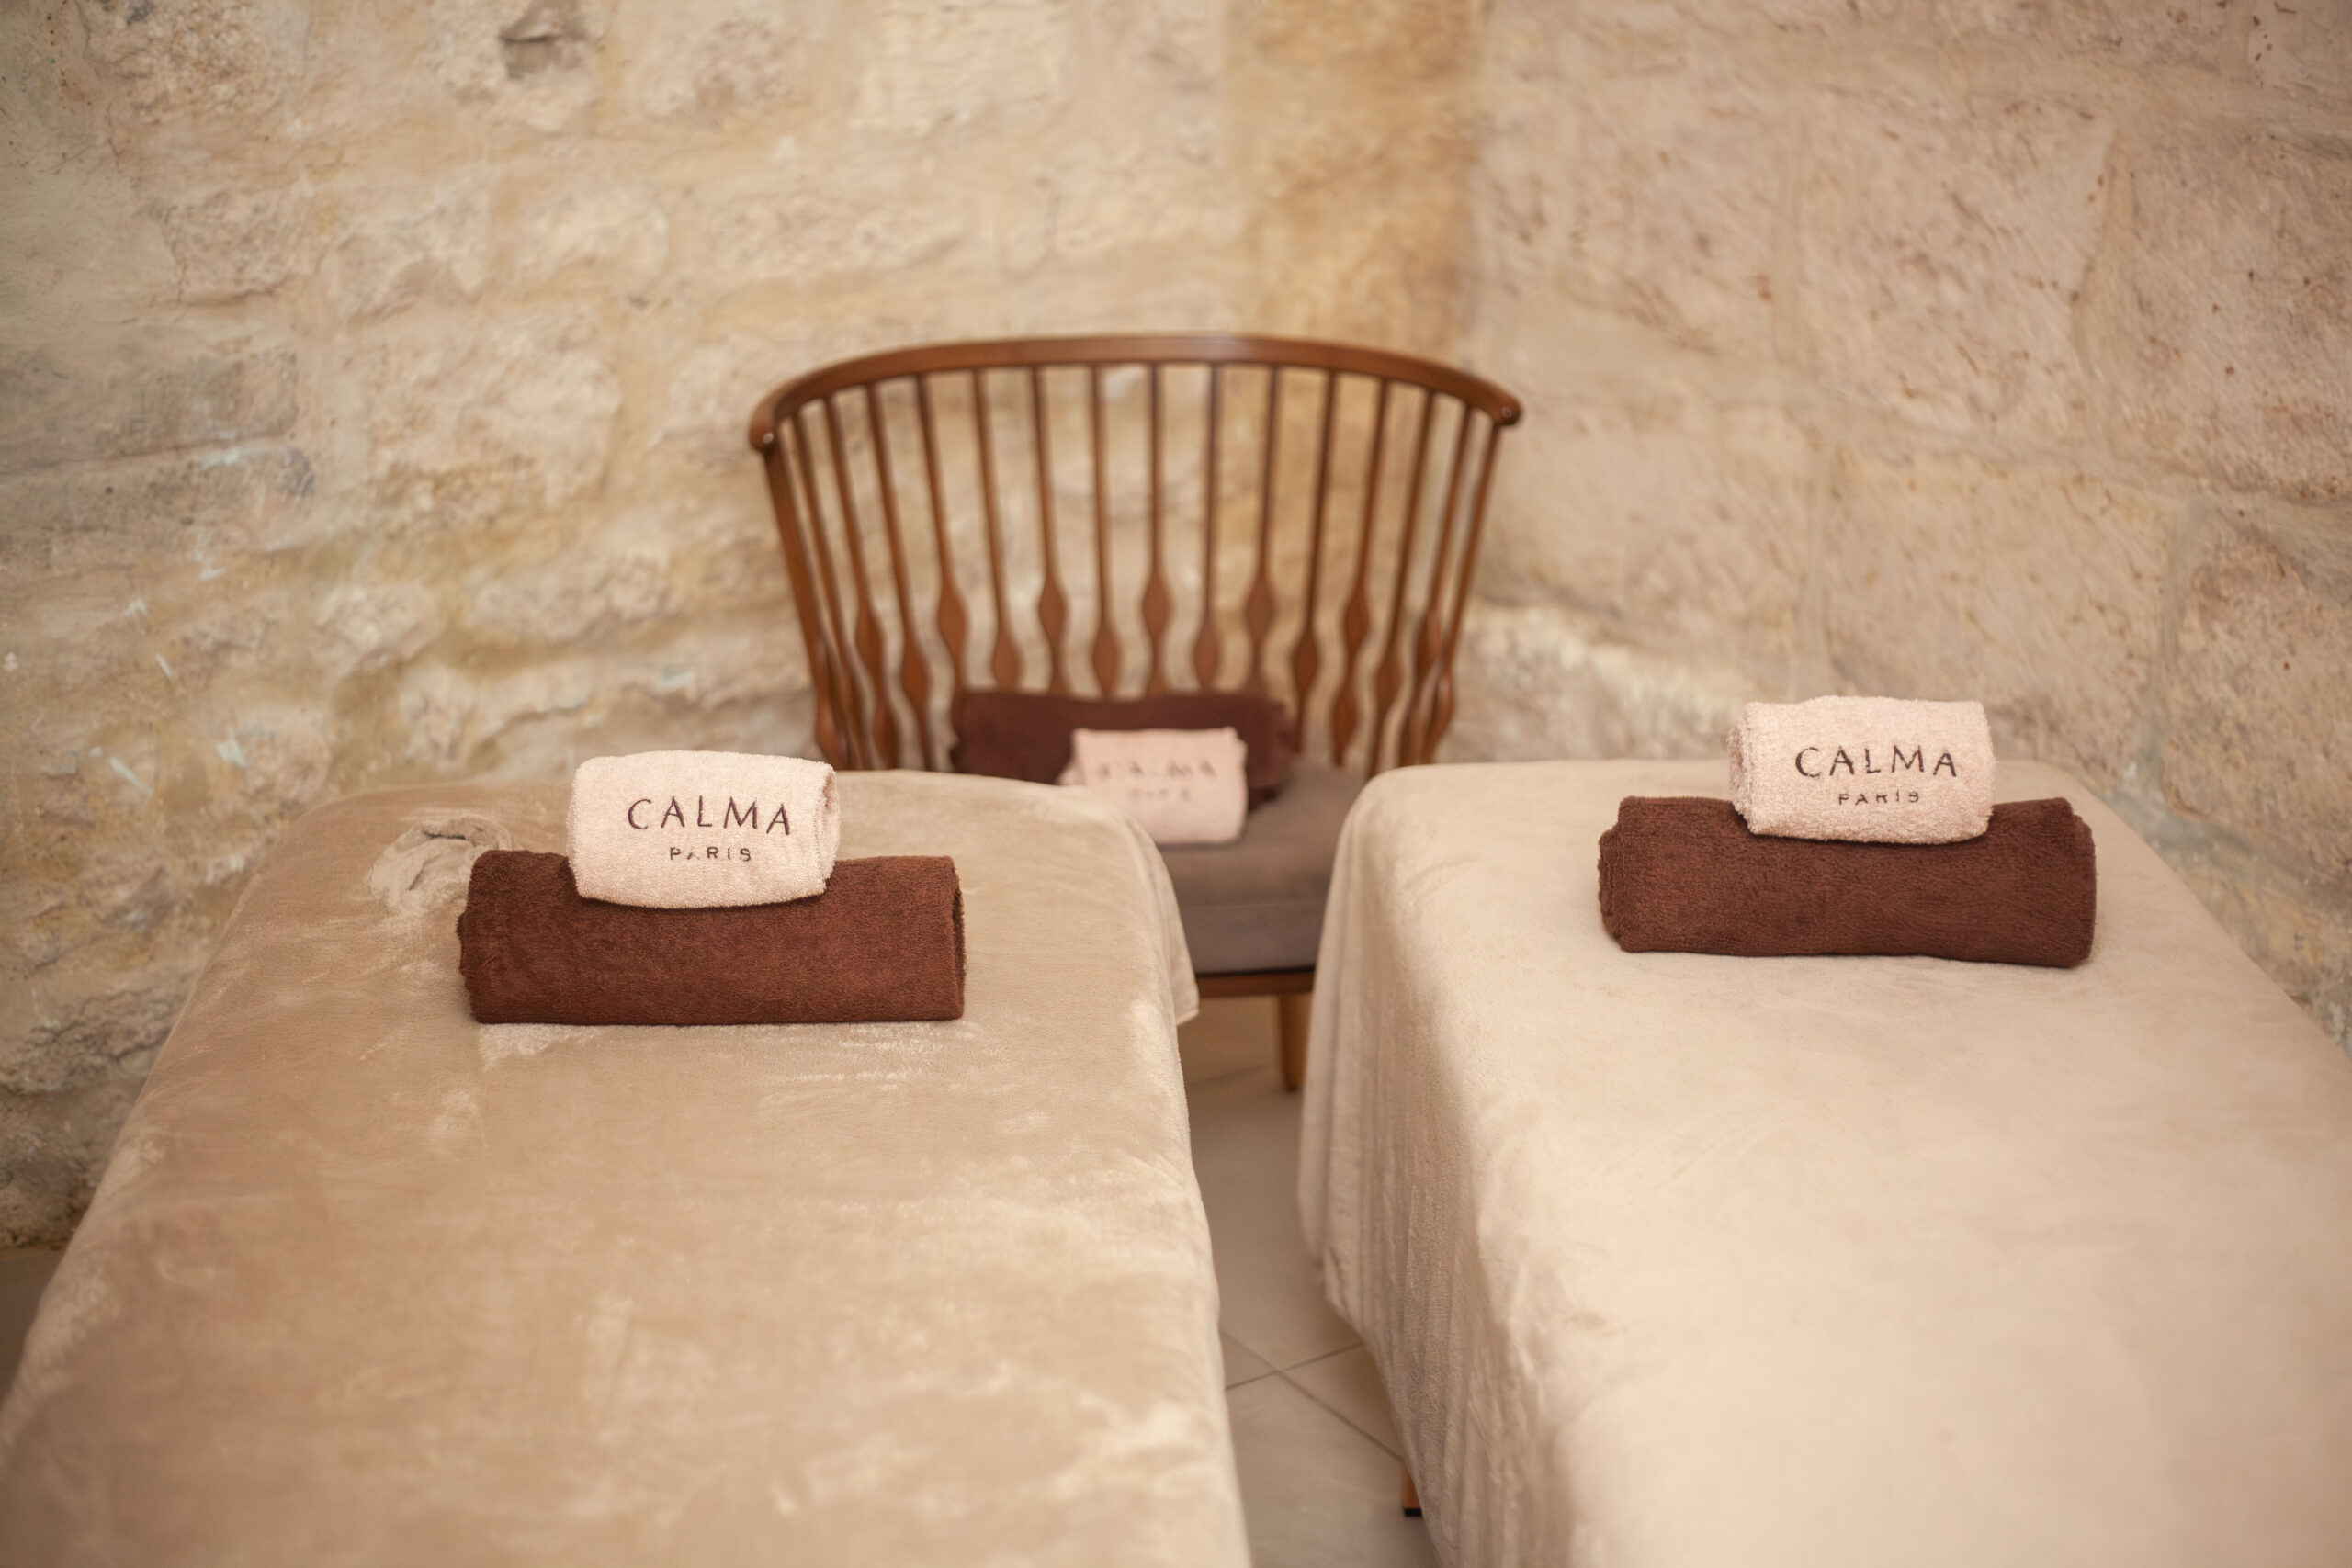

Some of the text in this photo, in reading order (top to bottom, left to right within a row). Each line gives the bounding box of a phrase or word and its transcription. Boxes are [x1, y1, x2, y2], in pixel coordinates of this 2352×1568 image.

[1795, 745, 1957, 778] CALMA
[1838, 790, 1919, 805] PARIS
[628, 795, 790, 836] CALMA
[669, 846, 752, 862] PARIS
